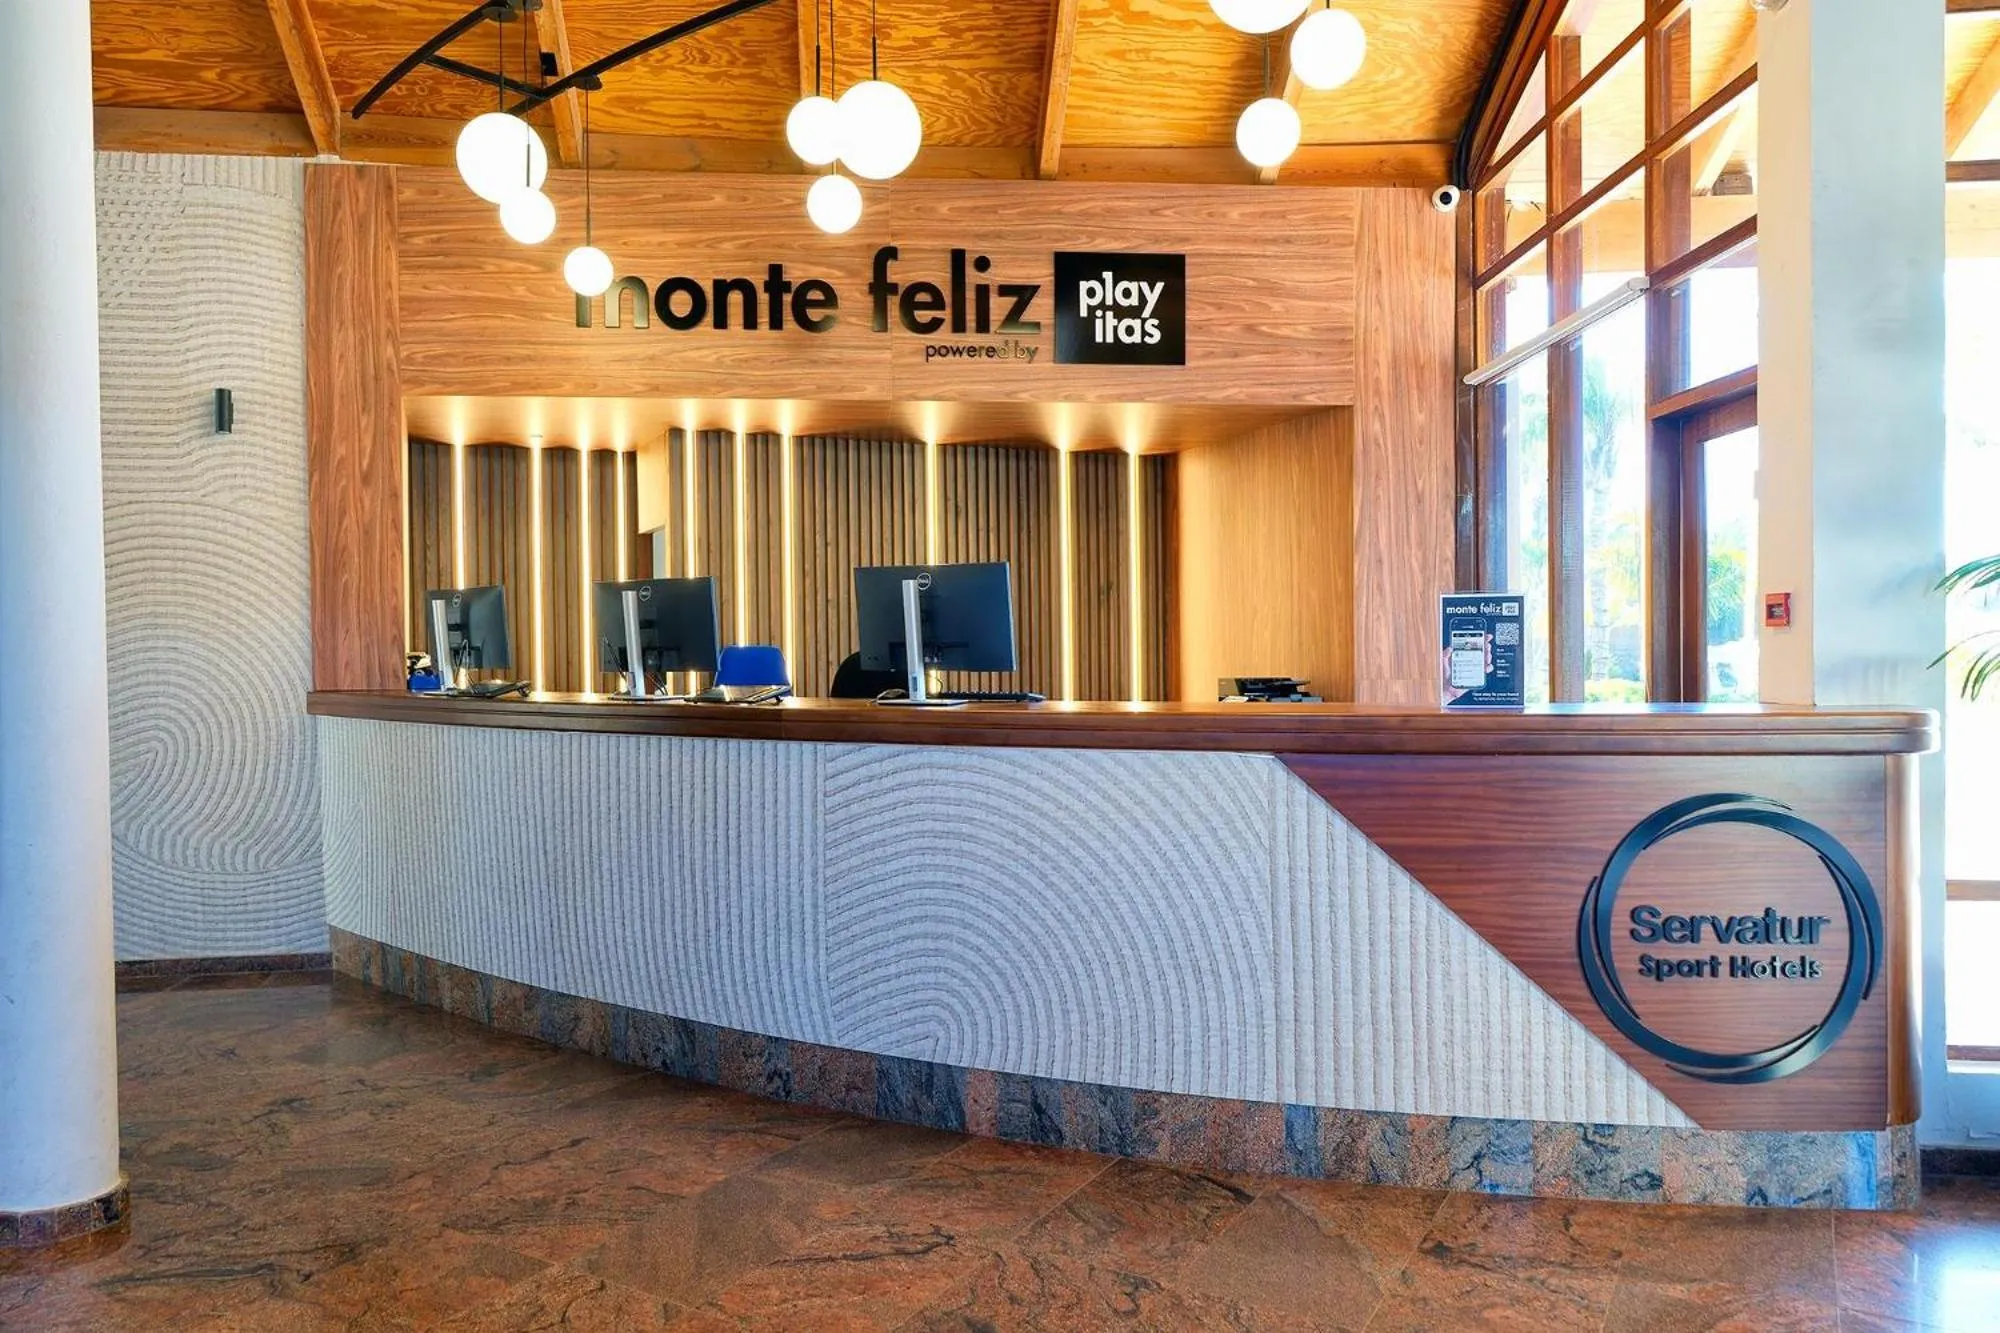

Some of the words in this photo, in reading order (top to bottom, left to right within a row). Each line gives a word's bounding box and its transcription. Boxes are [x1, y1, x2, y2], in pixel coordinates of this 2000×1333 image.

[575, 263, 839, 333] monte
[869, 246, 1041, 335] feliz
[1079, 271, 1165, 318] play
[1095, 309, 1161, 344] itas
[925, 339, 1009, 363] powered
[1014, 339, 1039, 364] by
[1446, 604, 1478, 614] monte
[1480, 602, 1501, 614] feliz
[1630, 904, 1831, 945] Servatur
[1638, 953, 1721, 982] Sport
[1729, 954, 1824, 979] Hotels
